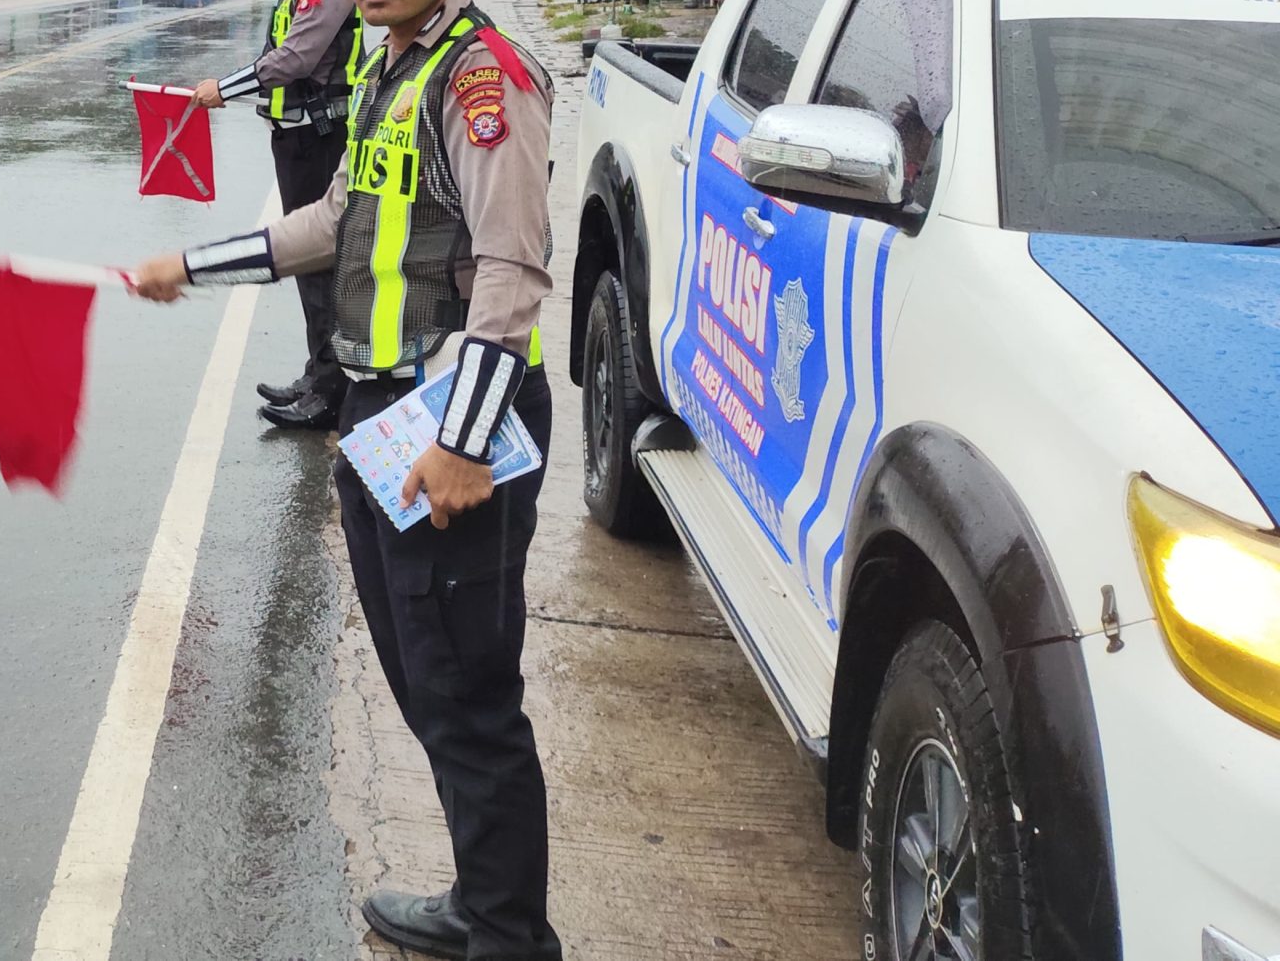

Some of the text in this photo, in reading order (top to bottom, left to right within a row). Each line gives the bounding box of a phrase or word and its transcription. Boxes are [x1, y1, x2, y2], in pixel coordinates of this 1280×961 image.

[376, 125, 410, 149] POLRI
[697, 211, 772, 357] POLISI
[690, 349, 765, 457] POLRES KATINGAN
[697, 303, 765, 409] LALU LINTAS
[865, 747, 880, 809] PRO
